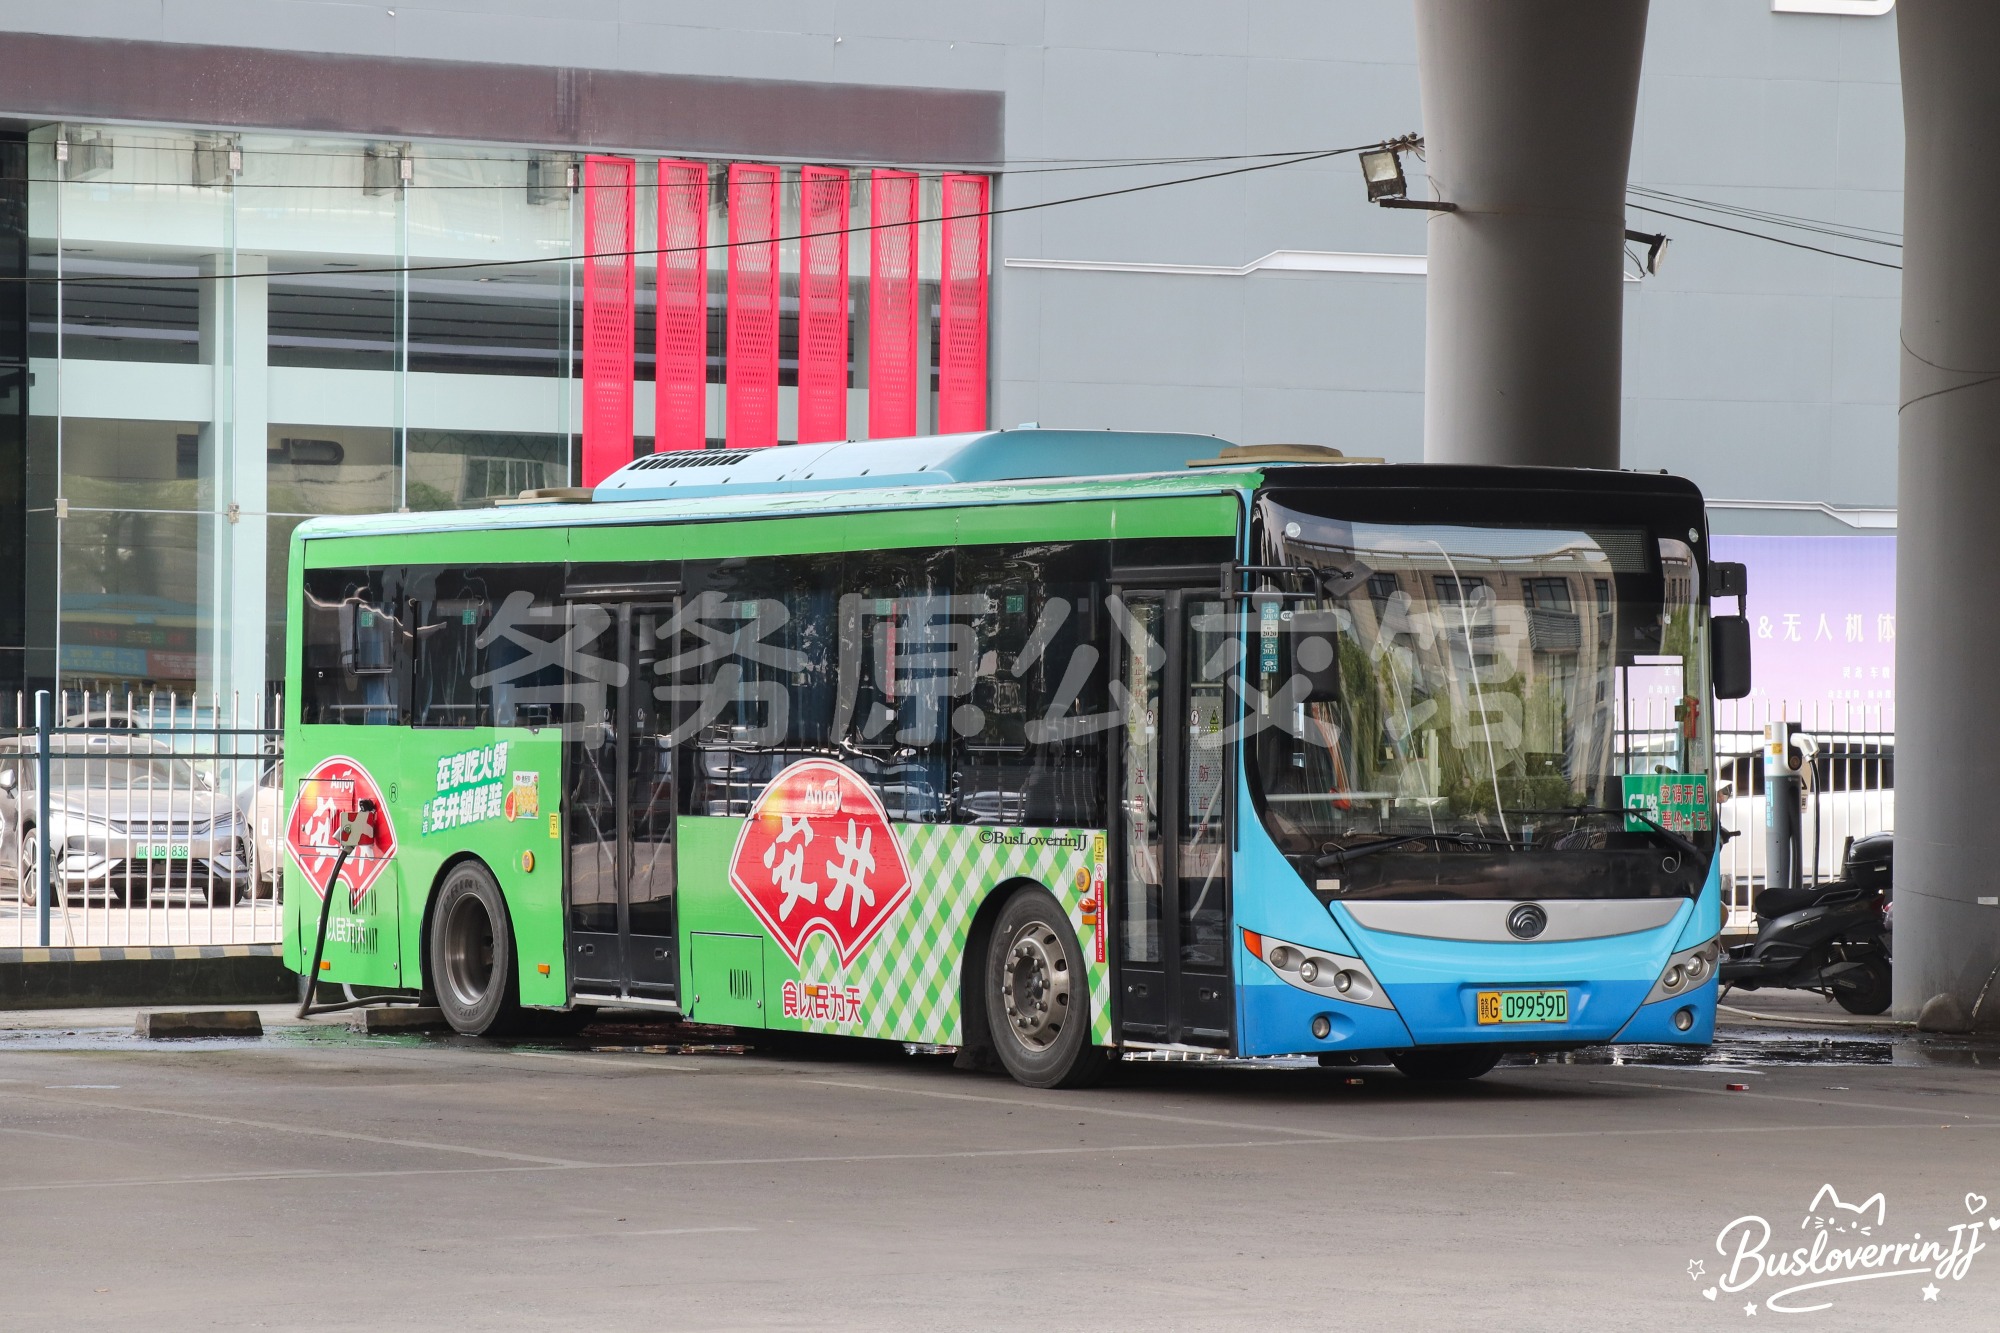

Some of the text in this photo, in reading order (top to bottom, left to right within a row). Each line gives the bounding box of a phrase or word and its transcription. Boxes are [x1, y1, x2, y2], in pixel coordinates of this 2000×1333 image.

[330, 774, 355, 793] Anjoy
[437, 742, 508, 791] 在家吃火锅
[431, 782, 502, 831] 安井锁鲜装
[804, 784, 843, 810] Anjoy
[1628, 793, 1659, 823] 67路
[1661, 783, 1705, 804] 空调开启
[1134, 767, 1145, 868] 注意开门
[1198, 765, 1210, 868] 防止夹伤
[763, 816, 876, 928] 安井
[783, 981, 862, 1023] 食以民为天
